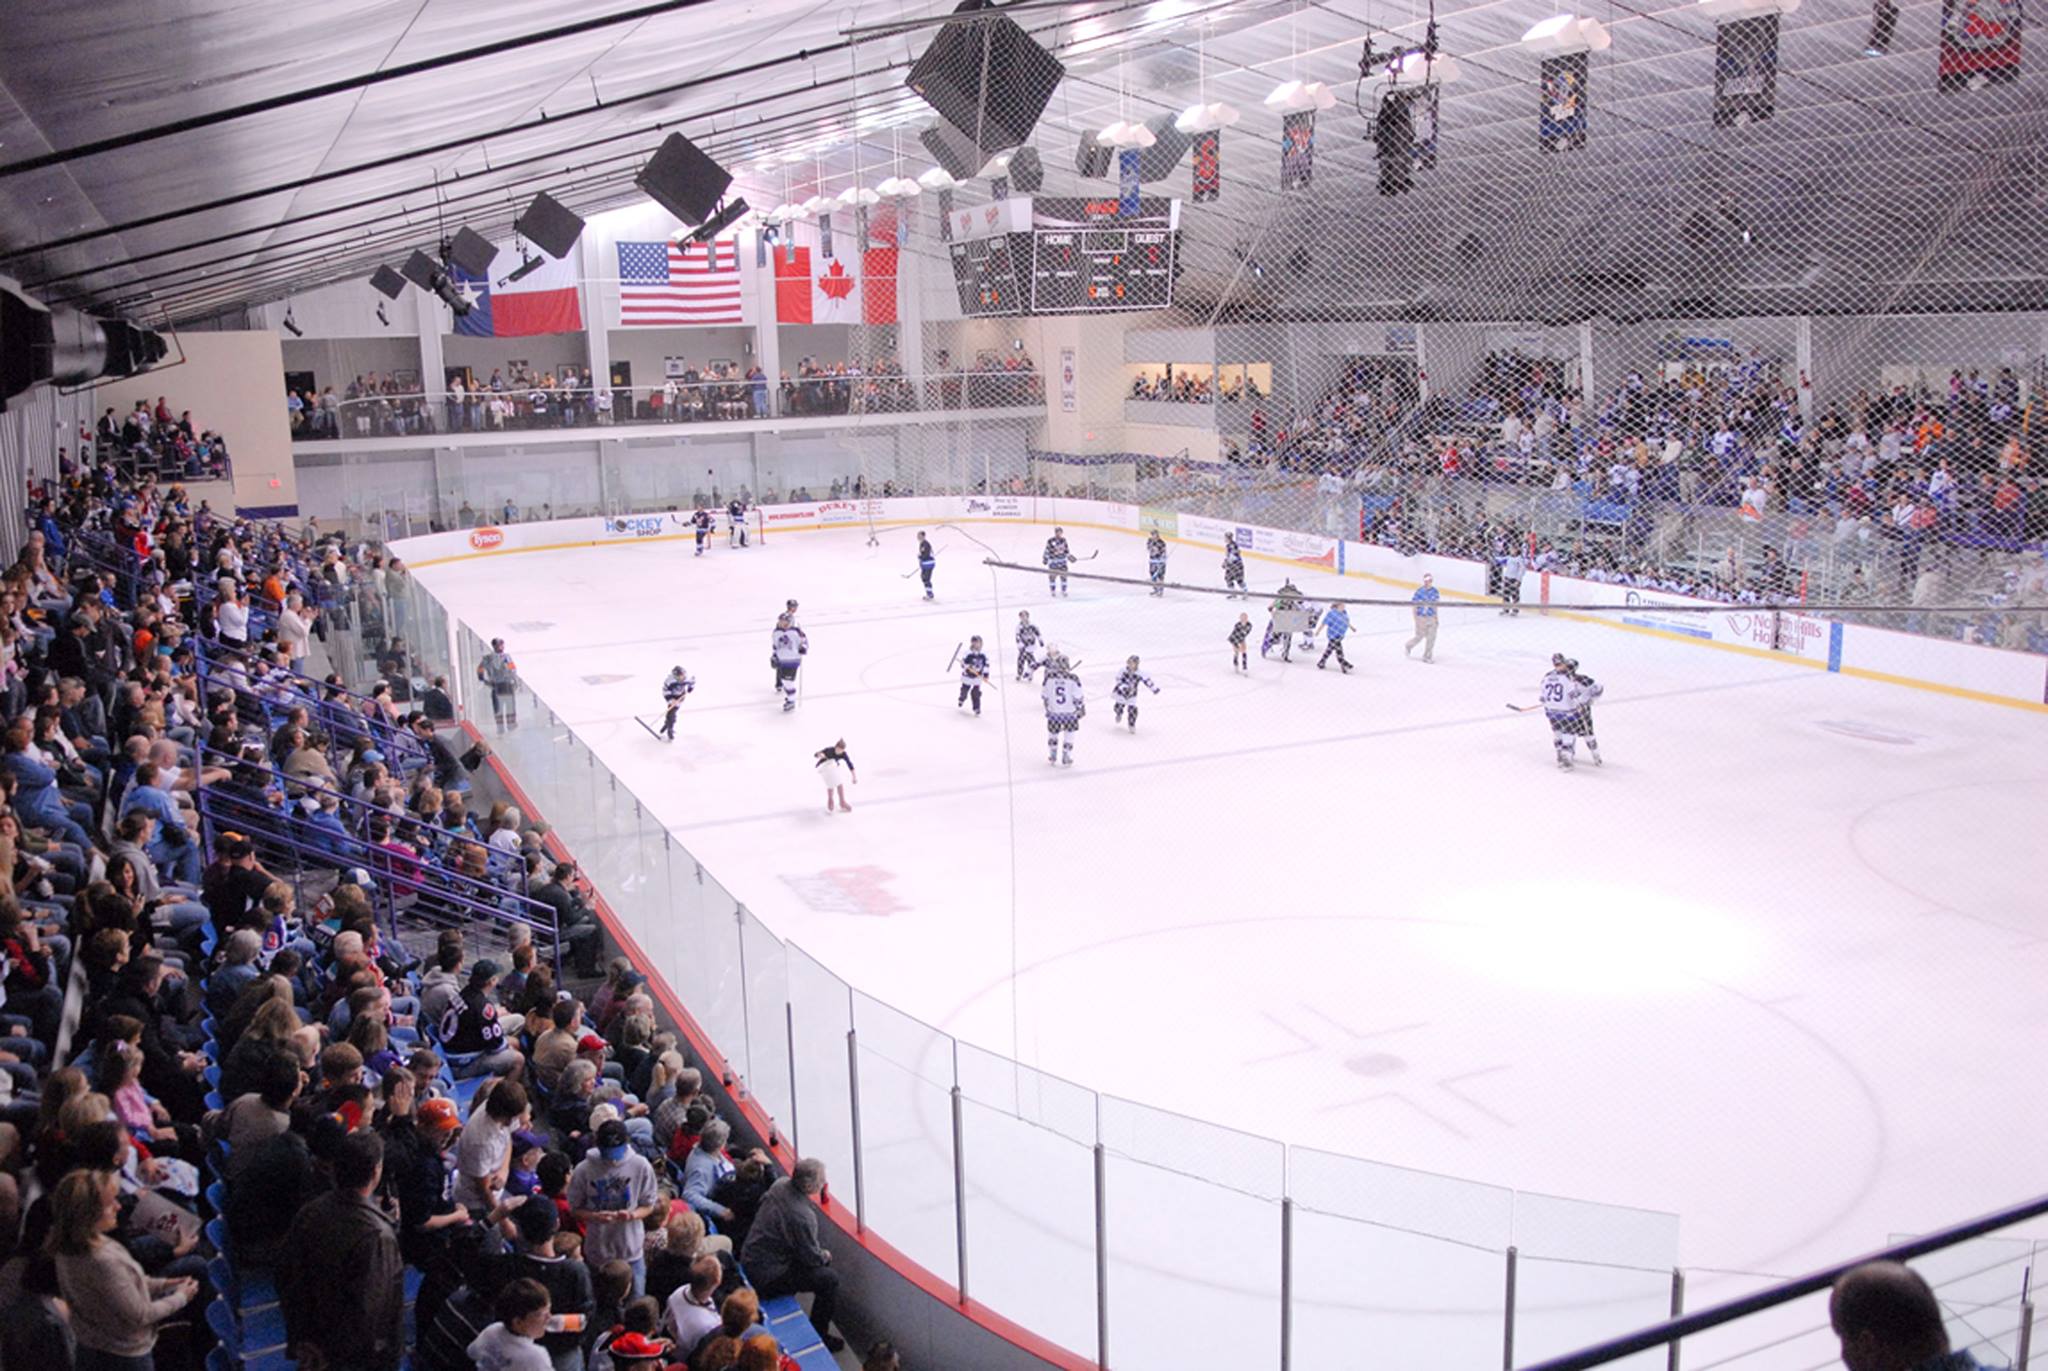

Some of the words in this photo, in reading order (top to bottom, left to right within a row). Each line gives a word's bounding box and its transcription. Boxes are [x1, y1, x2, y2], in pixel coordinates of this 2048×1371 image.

[1045, 234, 1072, 245] HOME
[1134, 233, 1164, 244] GUEST
[606, 516, 663, 533] HOCKEY
[636, 528, 662, 537] SHOP
[473, 533, 502, 547] Tyson
[1753, 613, 1793, 634] Noth
[1752, 628, 1805, 651] Hopital
[1055, 686, 1067, 705] 5
[1545, 682, 1564, 702] 79
[482, 1022, 502, 1041] 80
